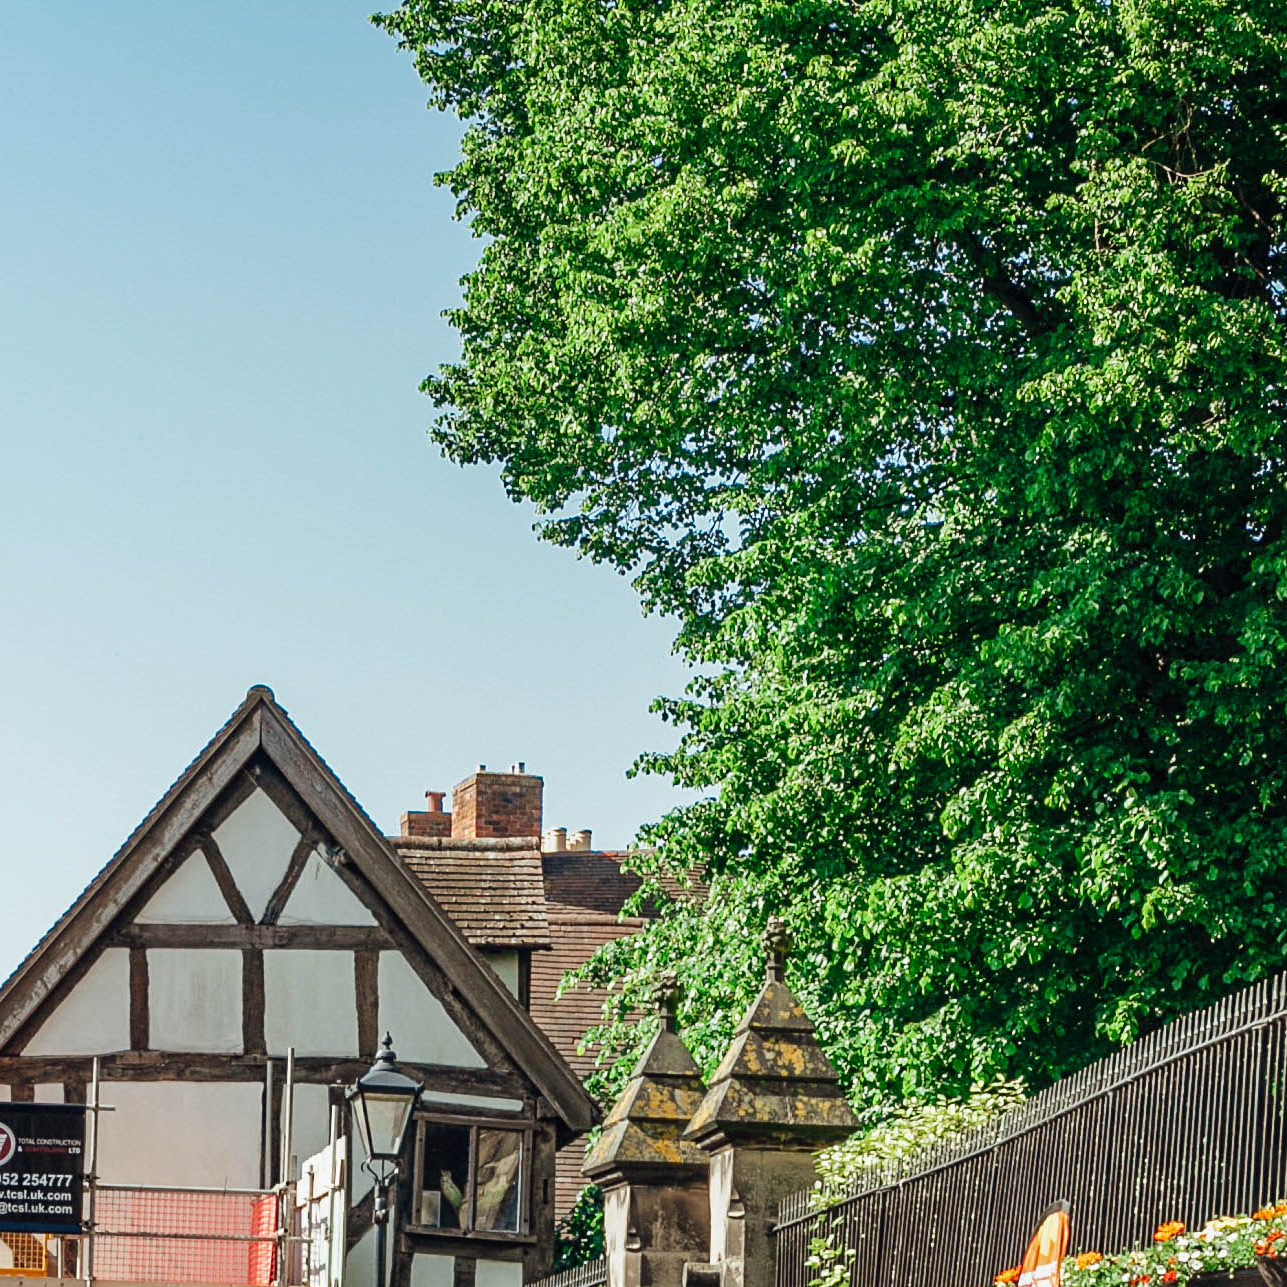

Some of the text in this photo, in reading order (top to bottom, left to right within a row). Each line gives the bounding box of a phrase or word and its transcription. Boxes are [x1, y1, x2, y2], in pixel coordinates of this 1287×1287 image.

[18, 1137, 82, 1146] TOTAL CONSTRUCTION
[22, 1174, 72, 1186] 254777
